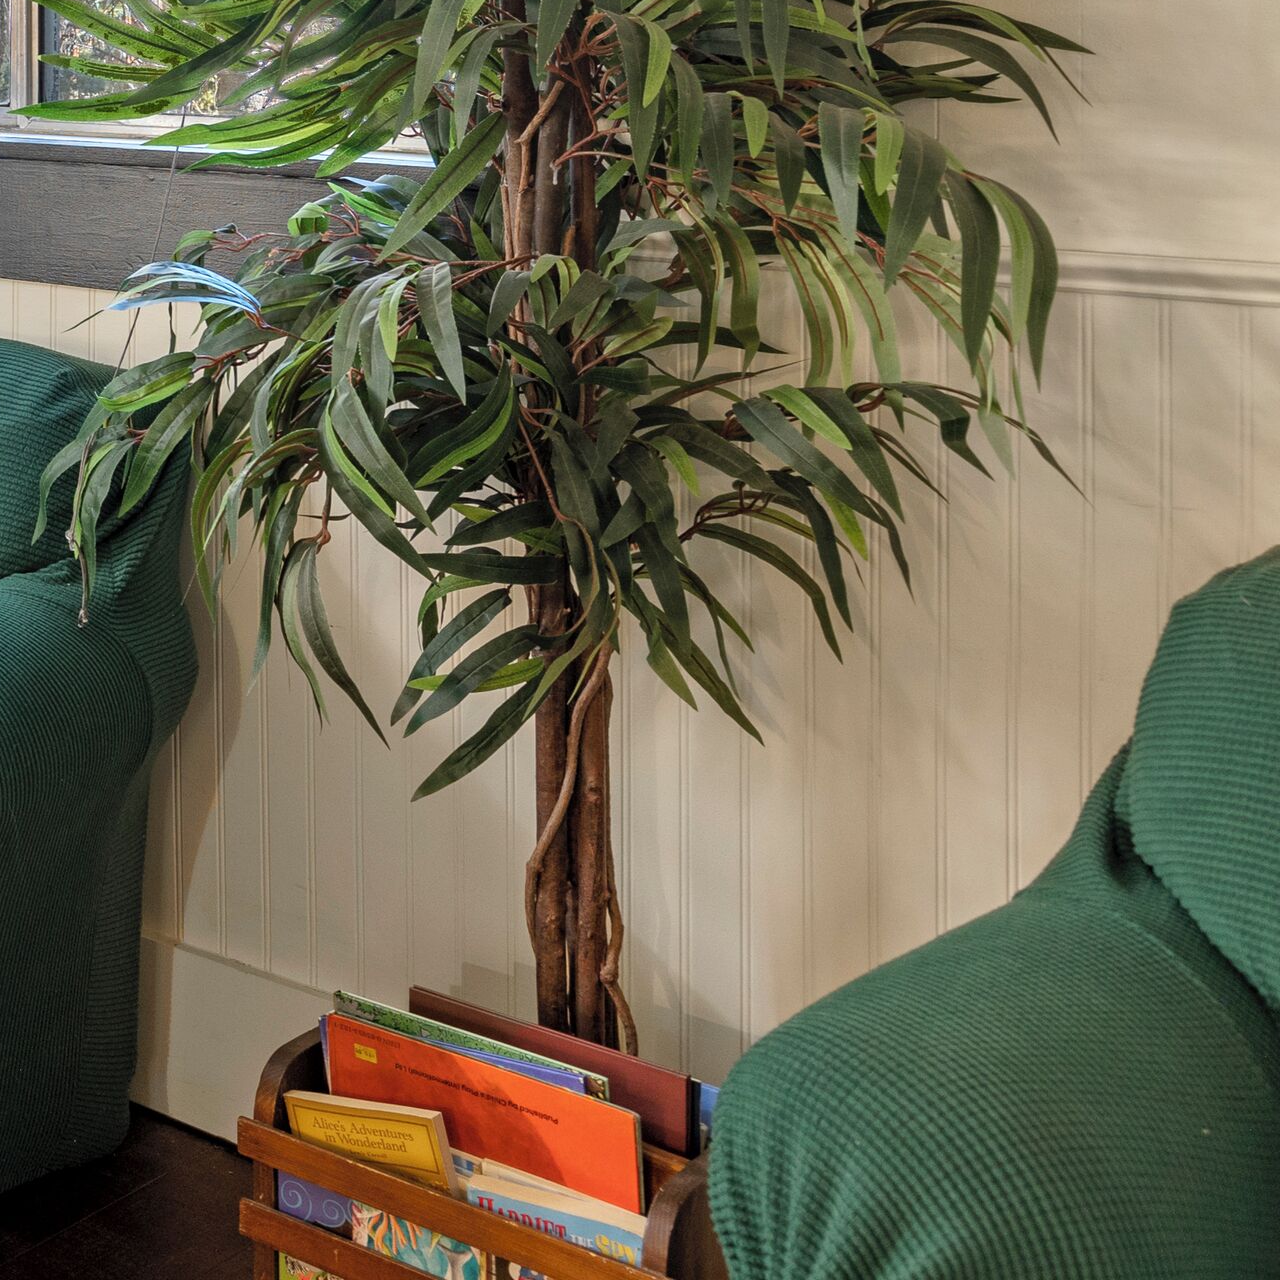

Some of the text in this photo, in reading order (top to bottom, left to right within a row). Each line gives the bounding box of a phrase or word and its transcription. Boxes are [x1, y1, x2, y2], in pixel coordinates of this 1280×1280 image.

[394, 1062, 559, 1124] Published by Play Ltd
[313, 1116, 414, 1141] Alice's Adventures
[325, 1132, 407, 1152] in Wonderland
[570, 1234, 594, 1248] THE
[594, 1234, 636, 1266] SPY
